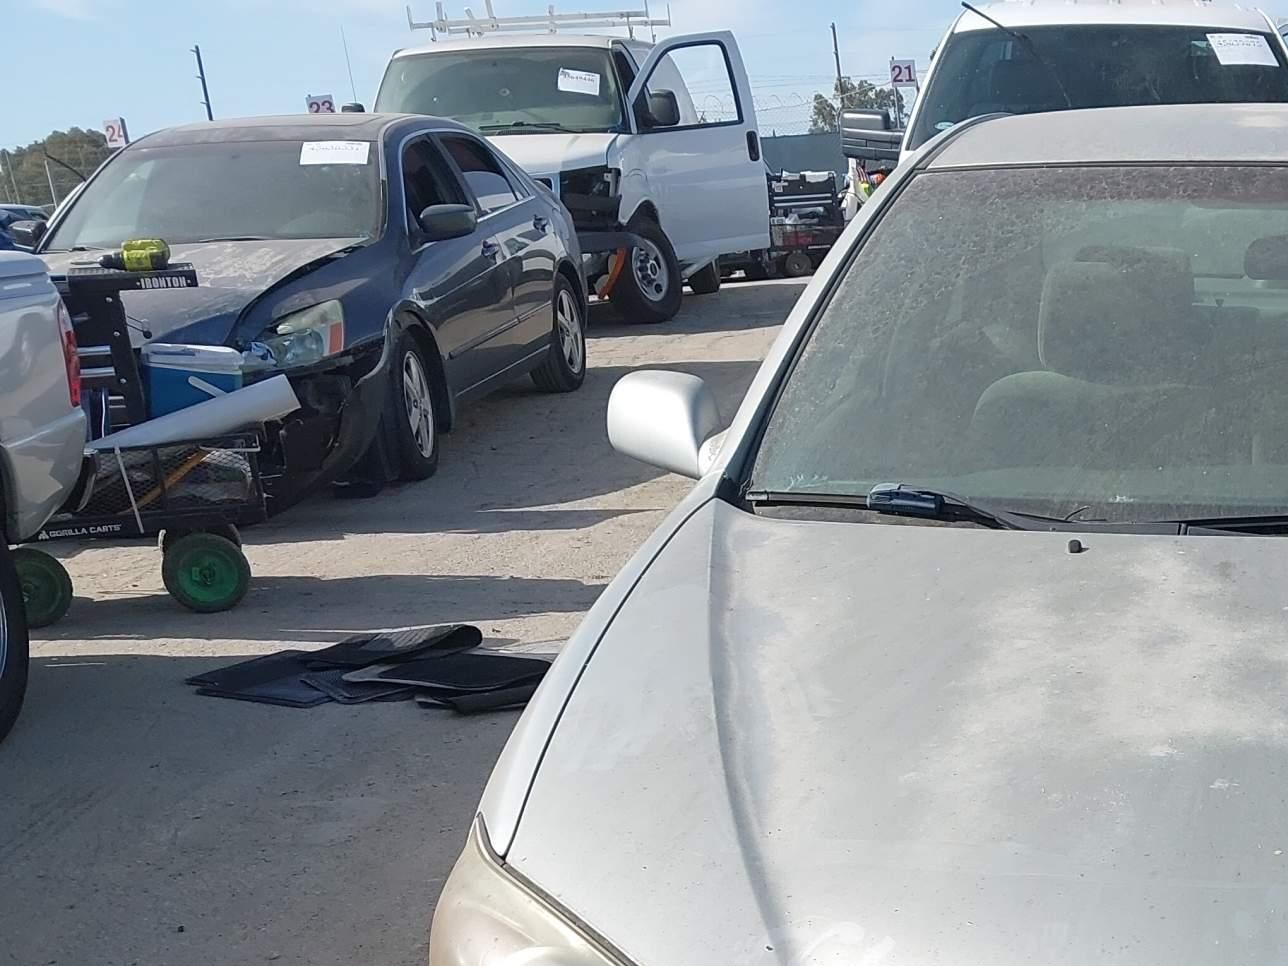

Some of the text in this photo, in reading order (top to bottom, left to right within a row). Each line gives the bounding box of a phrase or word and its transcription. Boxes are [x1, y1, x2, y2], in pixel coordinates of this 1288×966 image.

[891, 64, 915, 82] 21
[309, 100, 335, 113] 23
[140, 276, 187, 289] IRONTON
[49, 524, 121, 538] GORILLA CARTS
